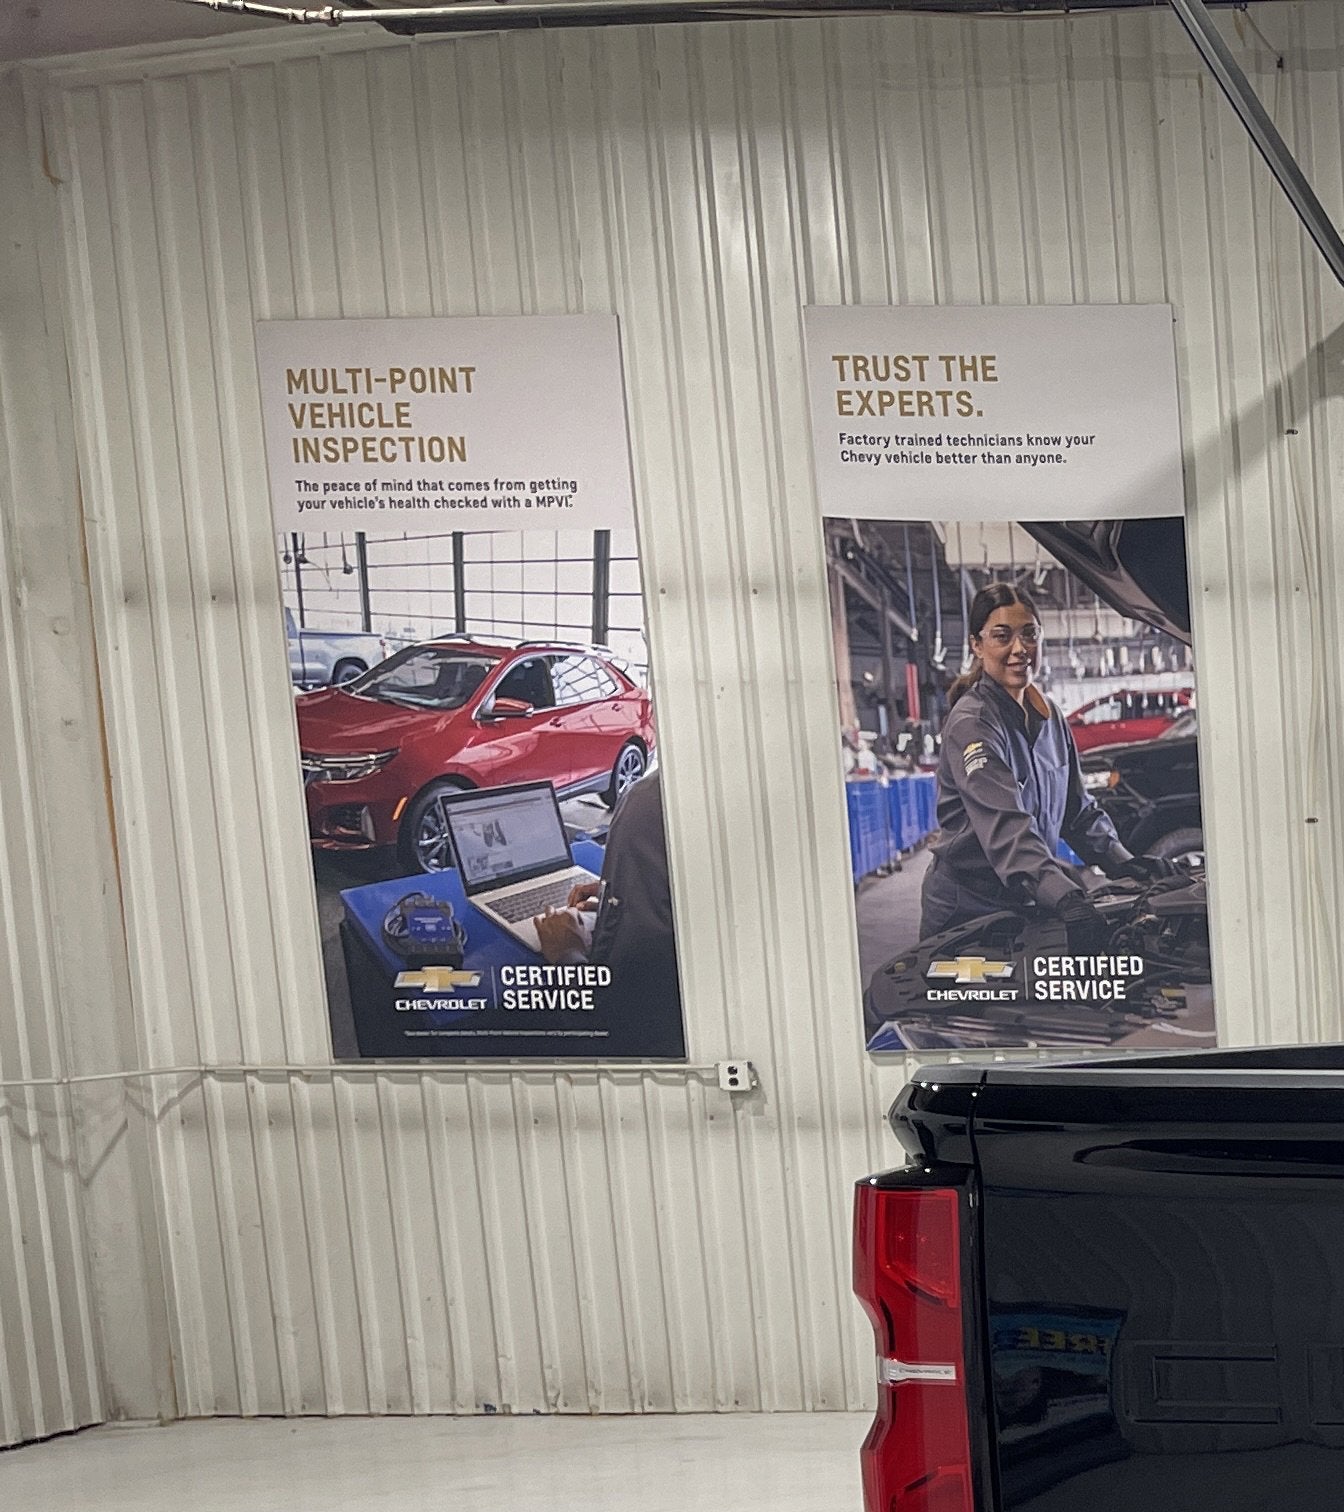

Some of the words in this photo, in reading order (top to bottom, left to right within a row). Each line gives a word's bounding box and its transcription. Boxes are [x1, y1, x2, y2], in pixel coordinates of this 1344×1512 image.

[832, 355, 929, 382] TRUST
[938, 355, 999, 382] THE
[286, 367, 476, 394] MULTI-POINT
[836, 390, 984, 417] EXPERTS.
[288, 402, 412, 429] VEHICLE
[292, 436, 467, 463] INSPECTION
[839, 433, 891, 448] Factory
[895, 433, 943, 446] trained
[946, 433, 1023, 447] technicians
[1027, 433, 1061, 446] know
[1065, 435, 1096, 448] your
[840, 450, 882, 466] Chevy
[885, 451, 932, 464] vehicle
[936, 451, 978, 464] better
[981, 452, 1012, 464] than
[1015, 453, 1067, 467] anyone.
[295, 480, 319, 492] The
[323, 482, 361, 495] peace
[364, 479, 378, 492] of
[381, 479, 413, 492] mind
[416, 479, 445, 492] that
[447, 480, 490, 491] comes
[493, 478, 526, 491] from
[529, 477, 577, 494] getting
[297, 499, 326, 513] your
[329, 496, 386, 509] vehicle's
[389, 496, 430, 509] health
[434, 496, 488, 509] checked
[491, 496, 521, 508] with
[524, 498, 532, 508] a
[501, 966, 611, 986] CERTIFIED
[1033, 956, 1143, 977] CERTIFIED
[503, 989, 595, 1010] SERVICE
[926, 989, 1019, 1001] CHEVROLET
[1034, 980, 1126, 1000] SERVICE
[395, 998, 488, 1011] CHEVROLET
